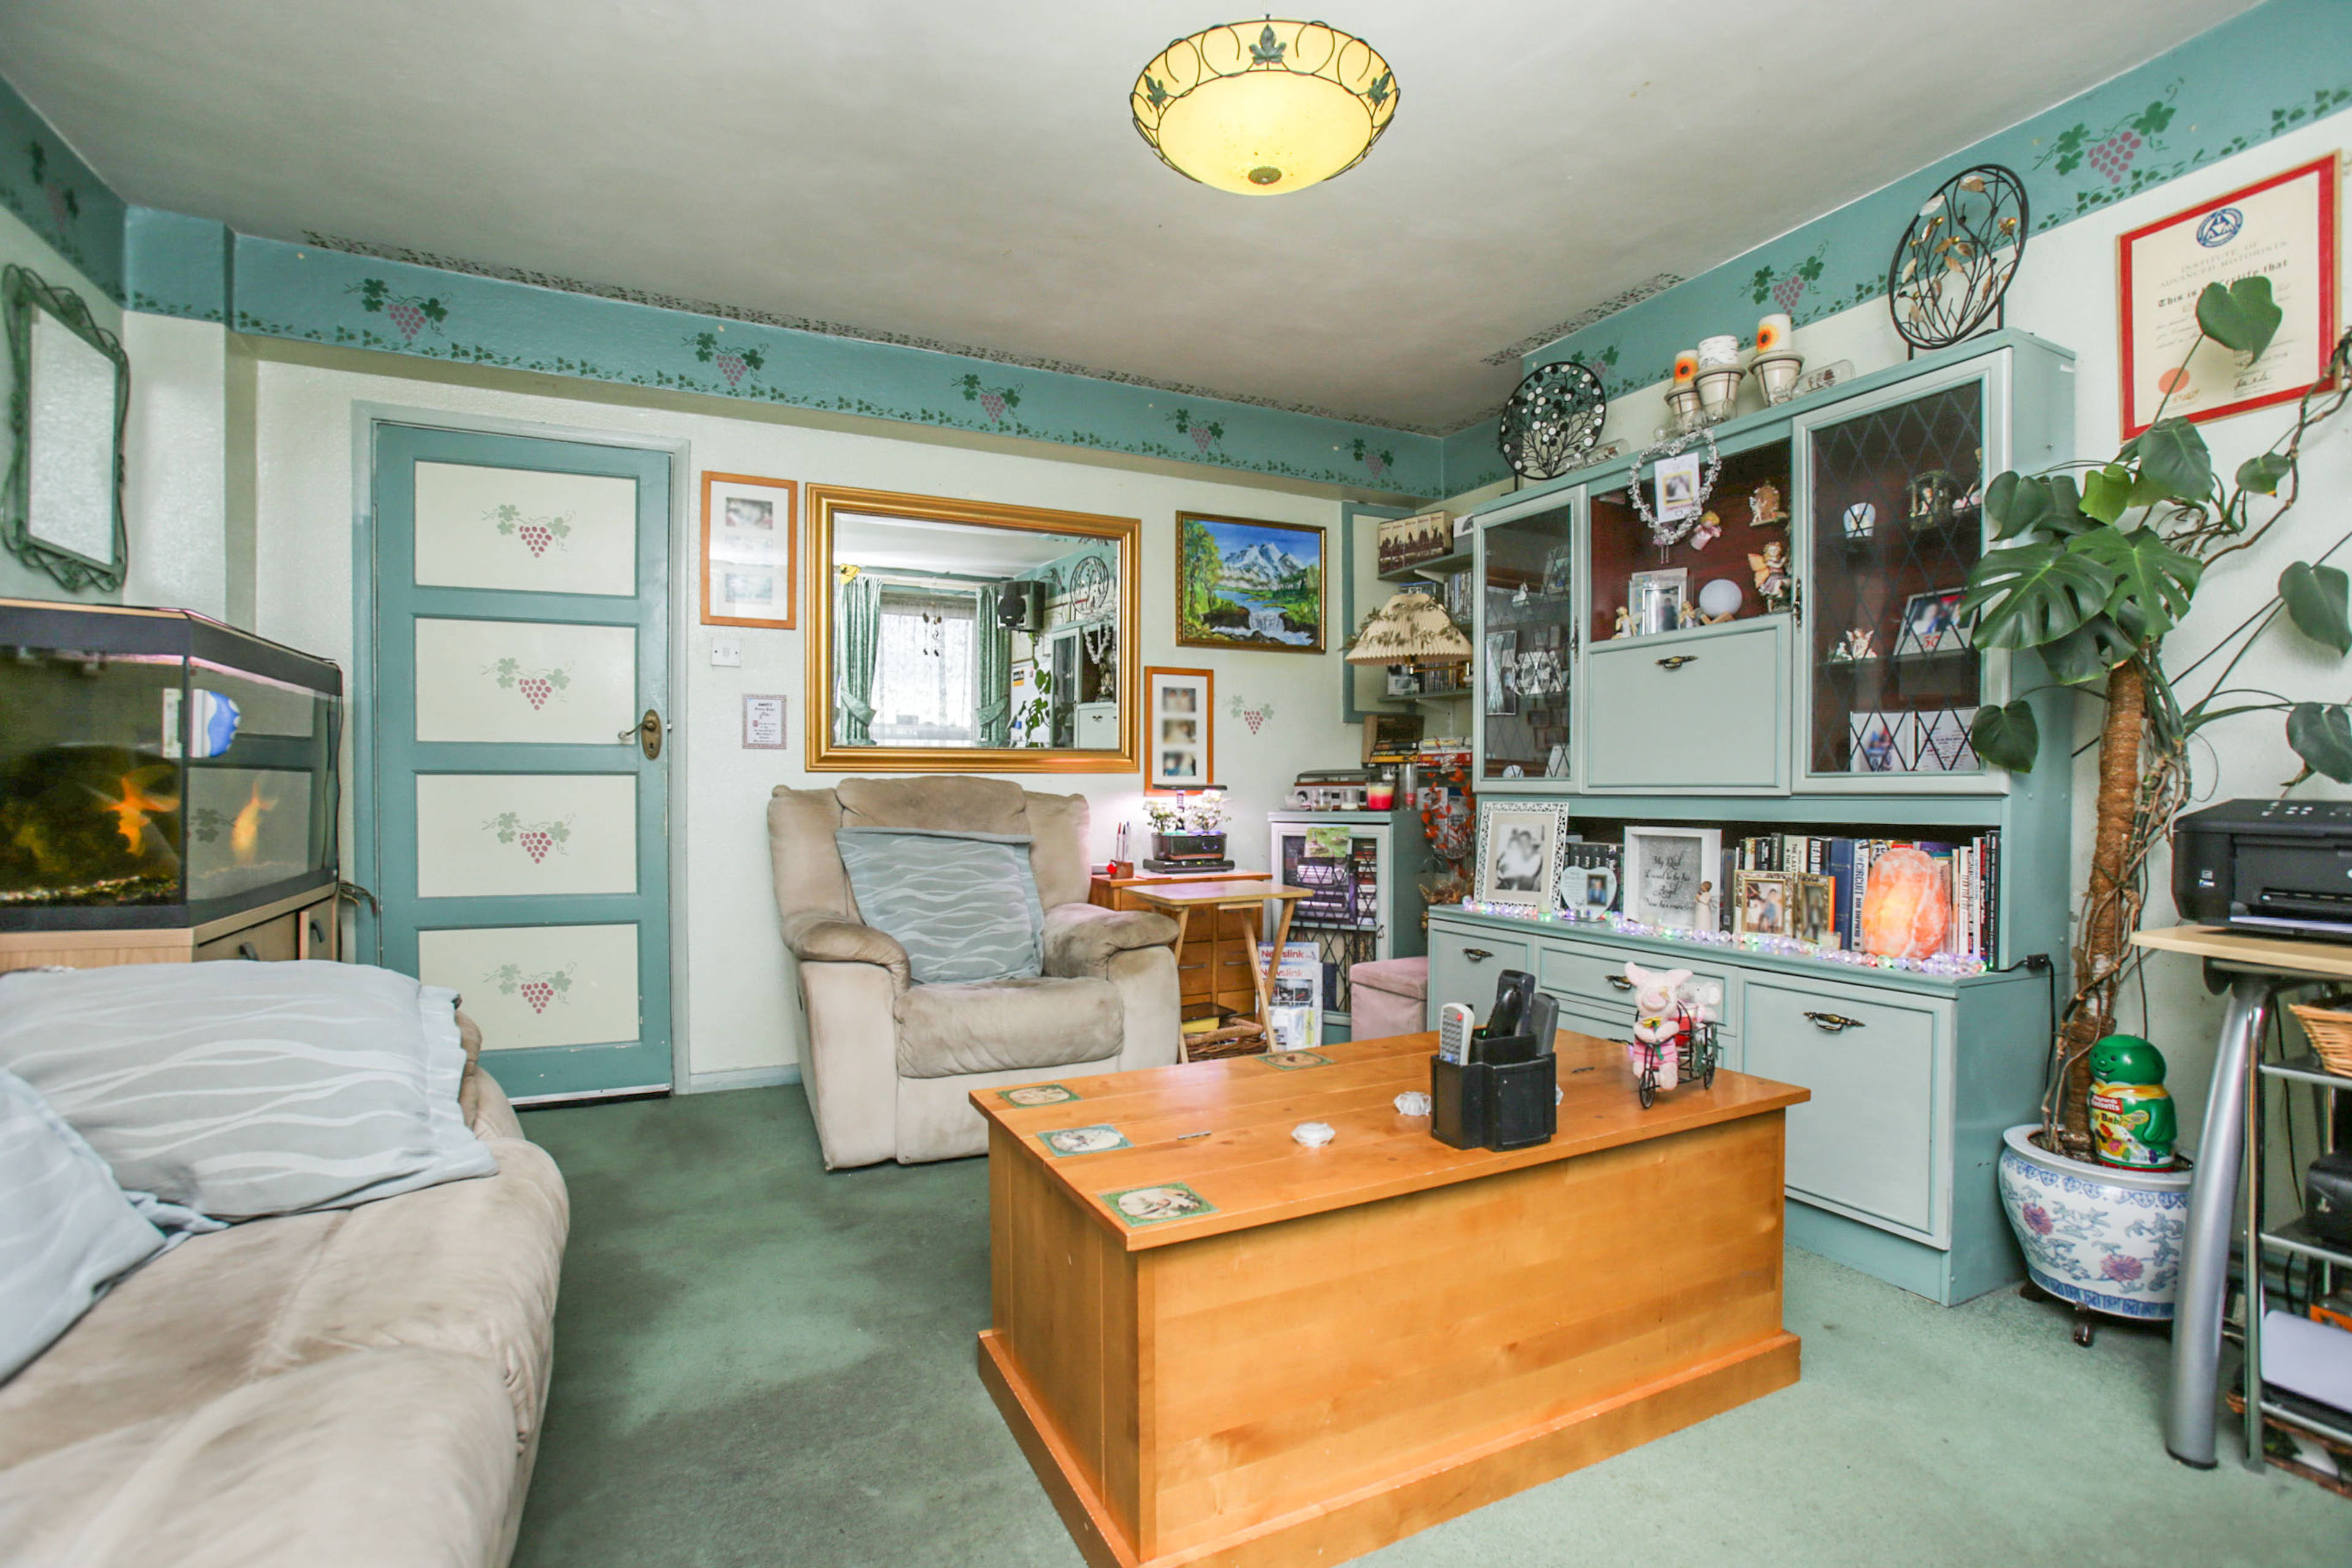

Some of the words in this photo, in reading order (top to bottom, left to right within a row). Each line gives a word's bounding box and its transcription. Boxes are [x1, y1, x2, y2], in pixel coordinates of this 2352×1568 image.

[2158, 294, 2182, 307] This
[2263, 260, 2288, 273] that
[1855, 862, 1864, 895] CIRCUIT
[1262, 949, 1304, 958] Neslink
